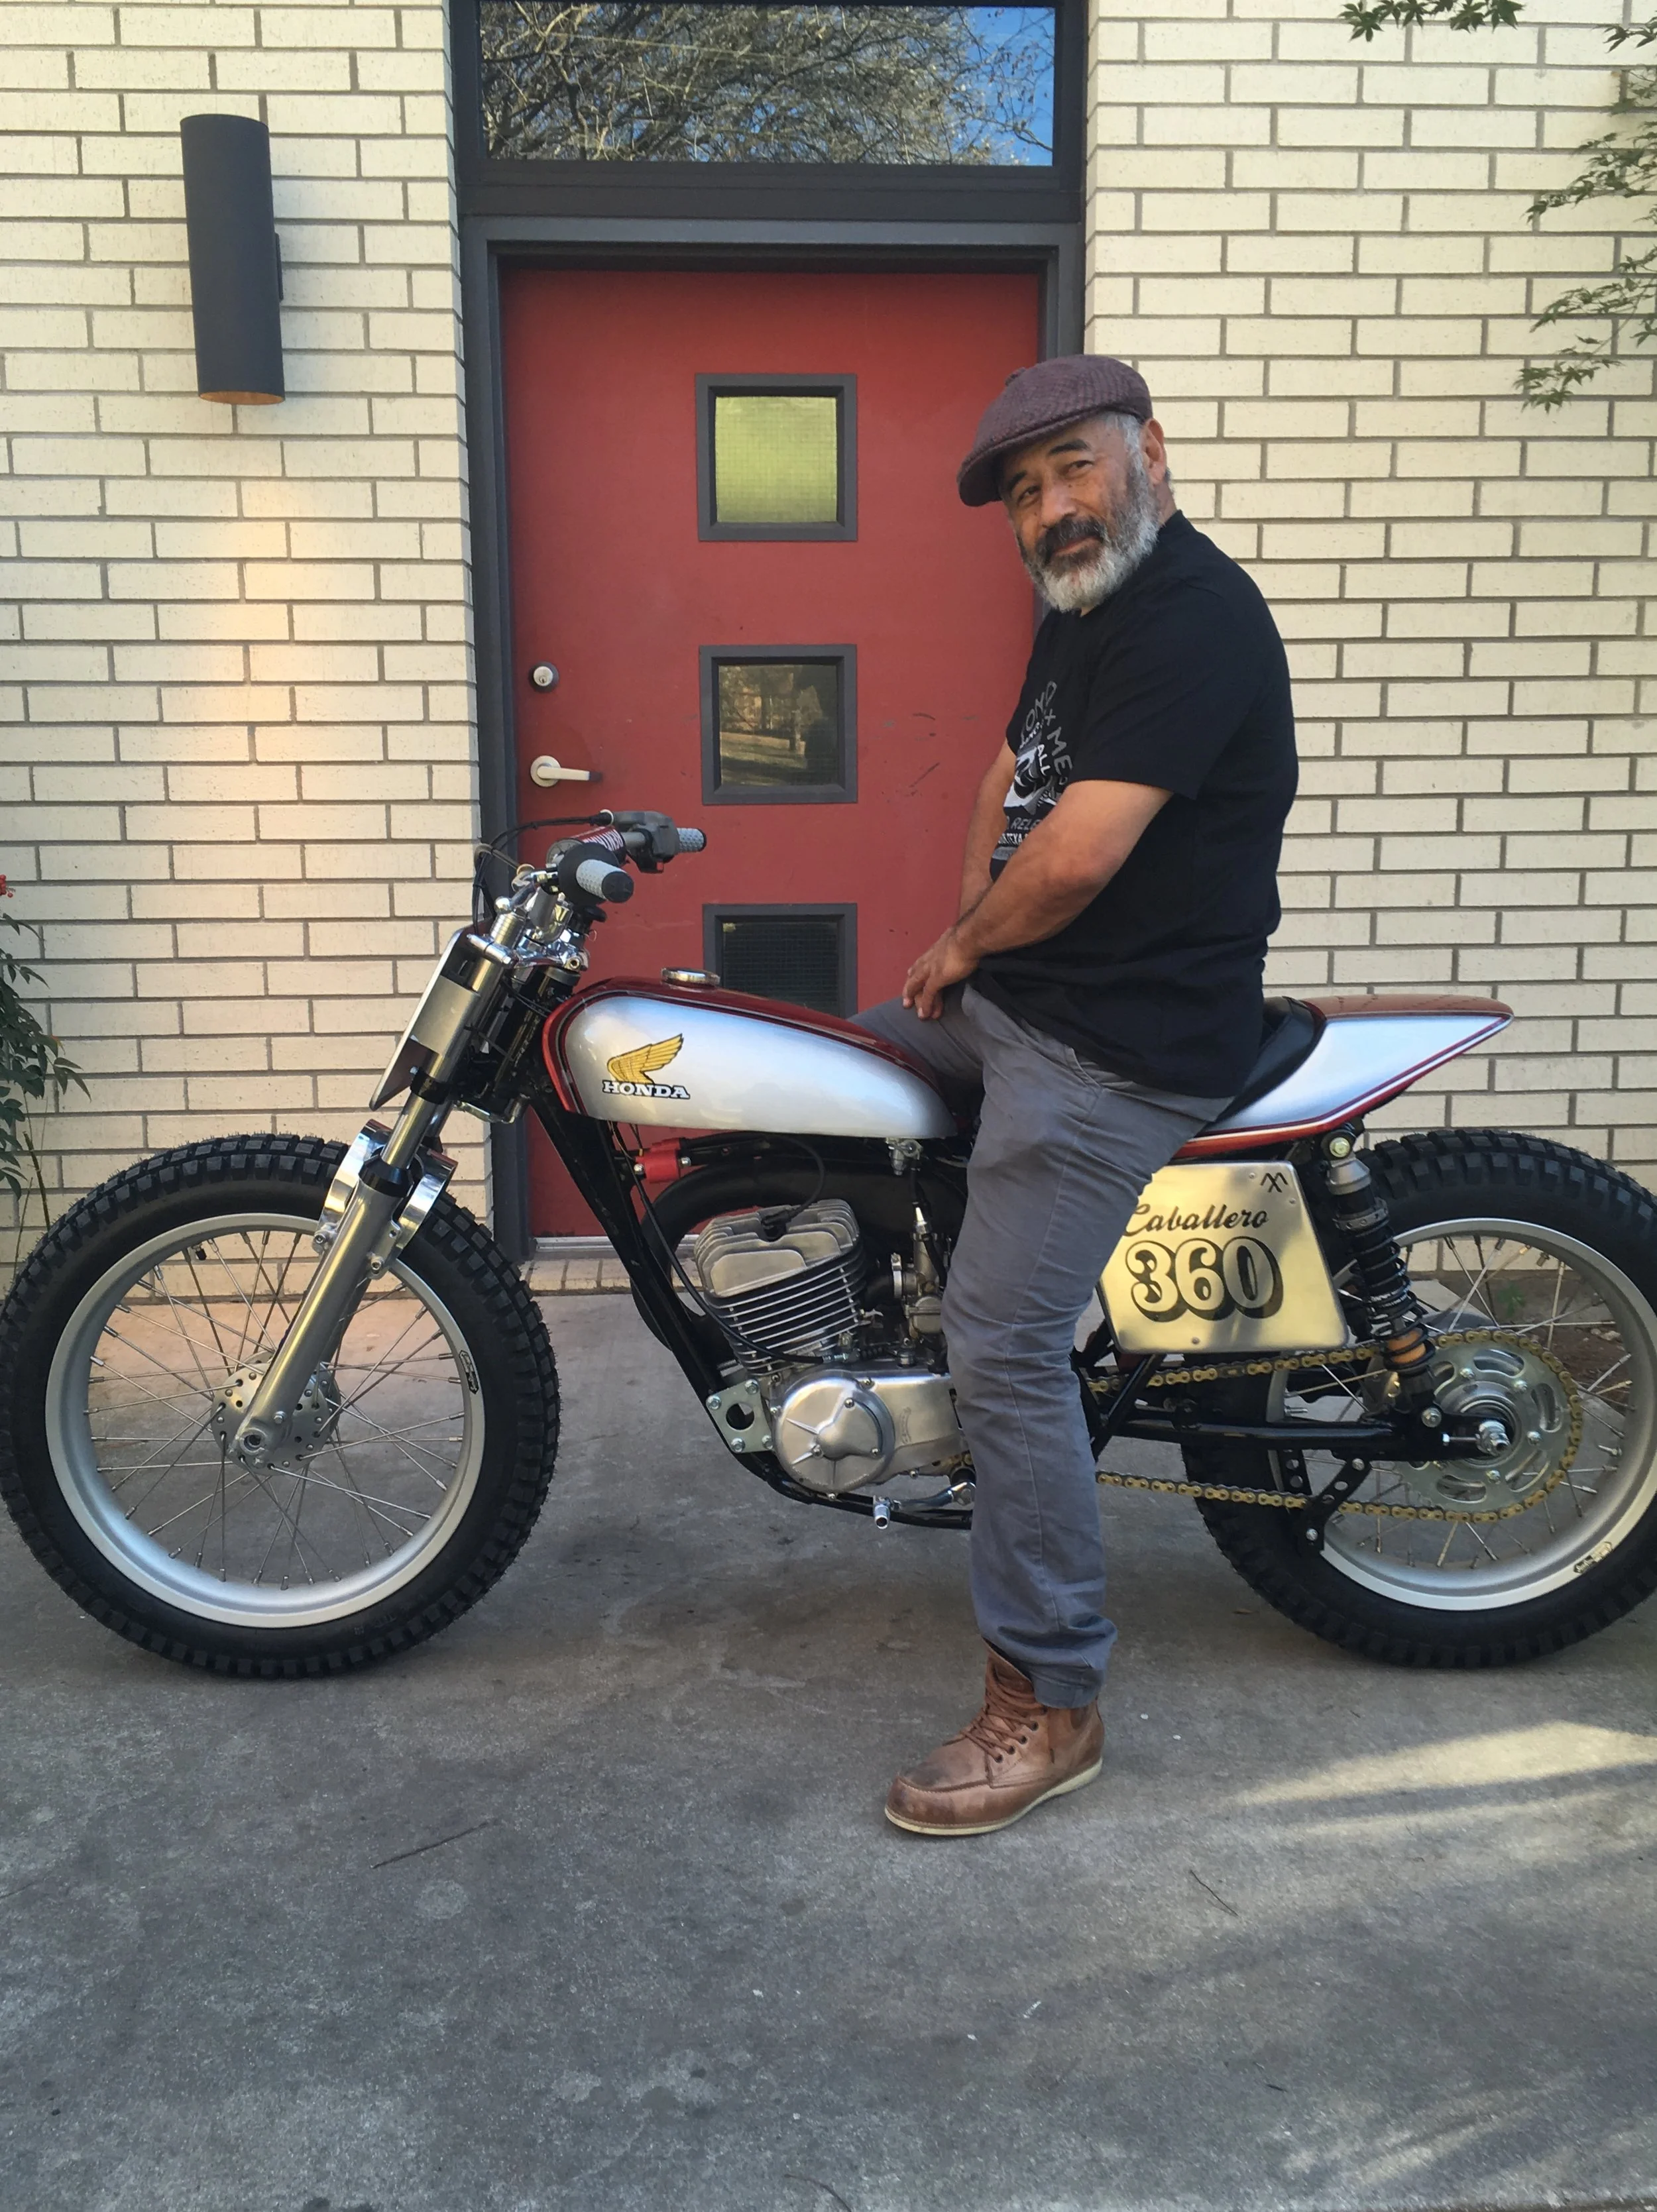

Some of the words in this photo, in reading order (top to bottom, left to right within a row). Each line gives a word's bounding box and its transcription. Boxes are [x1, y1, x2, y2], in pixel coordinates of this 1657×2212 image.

[602, 1079, 691, 1099] HONDA
[1125, 1203, 1269, 1237] Caballero
[1125, 1235, 1284, 1323] 360
